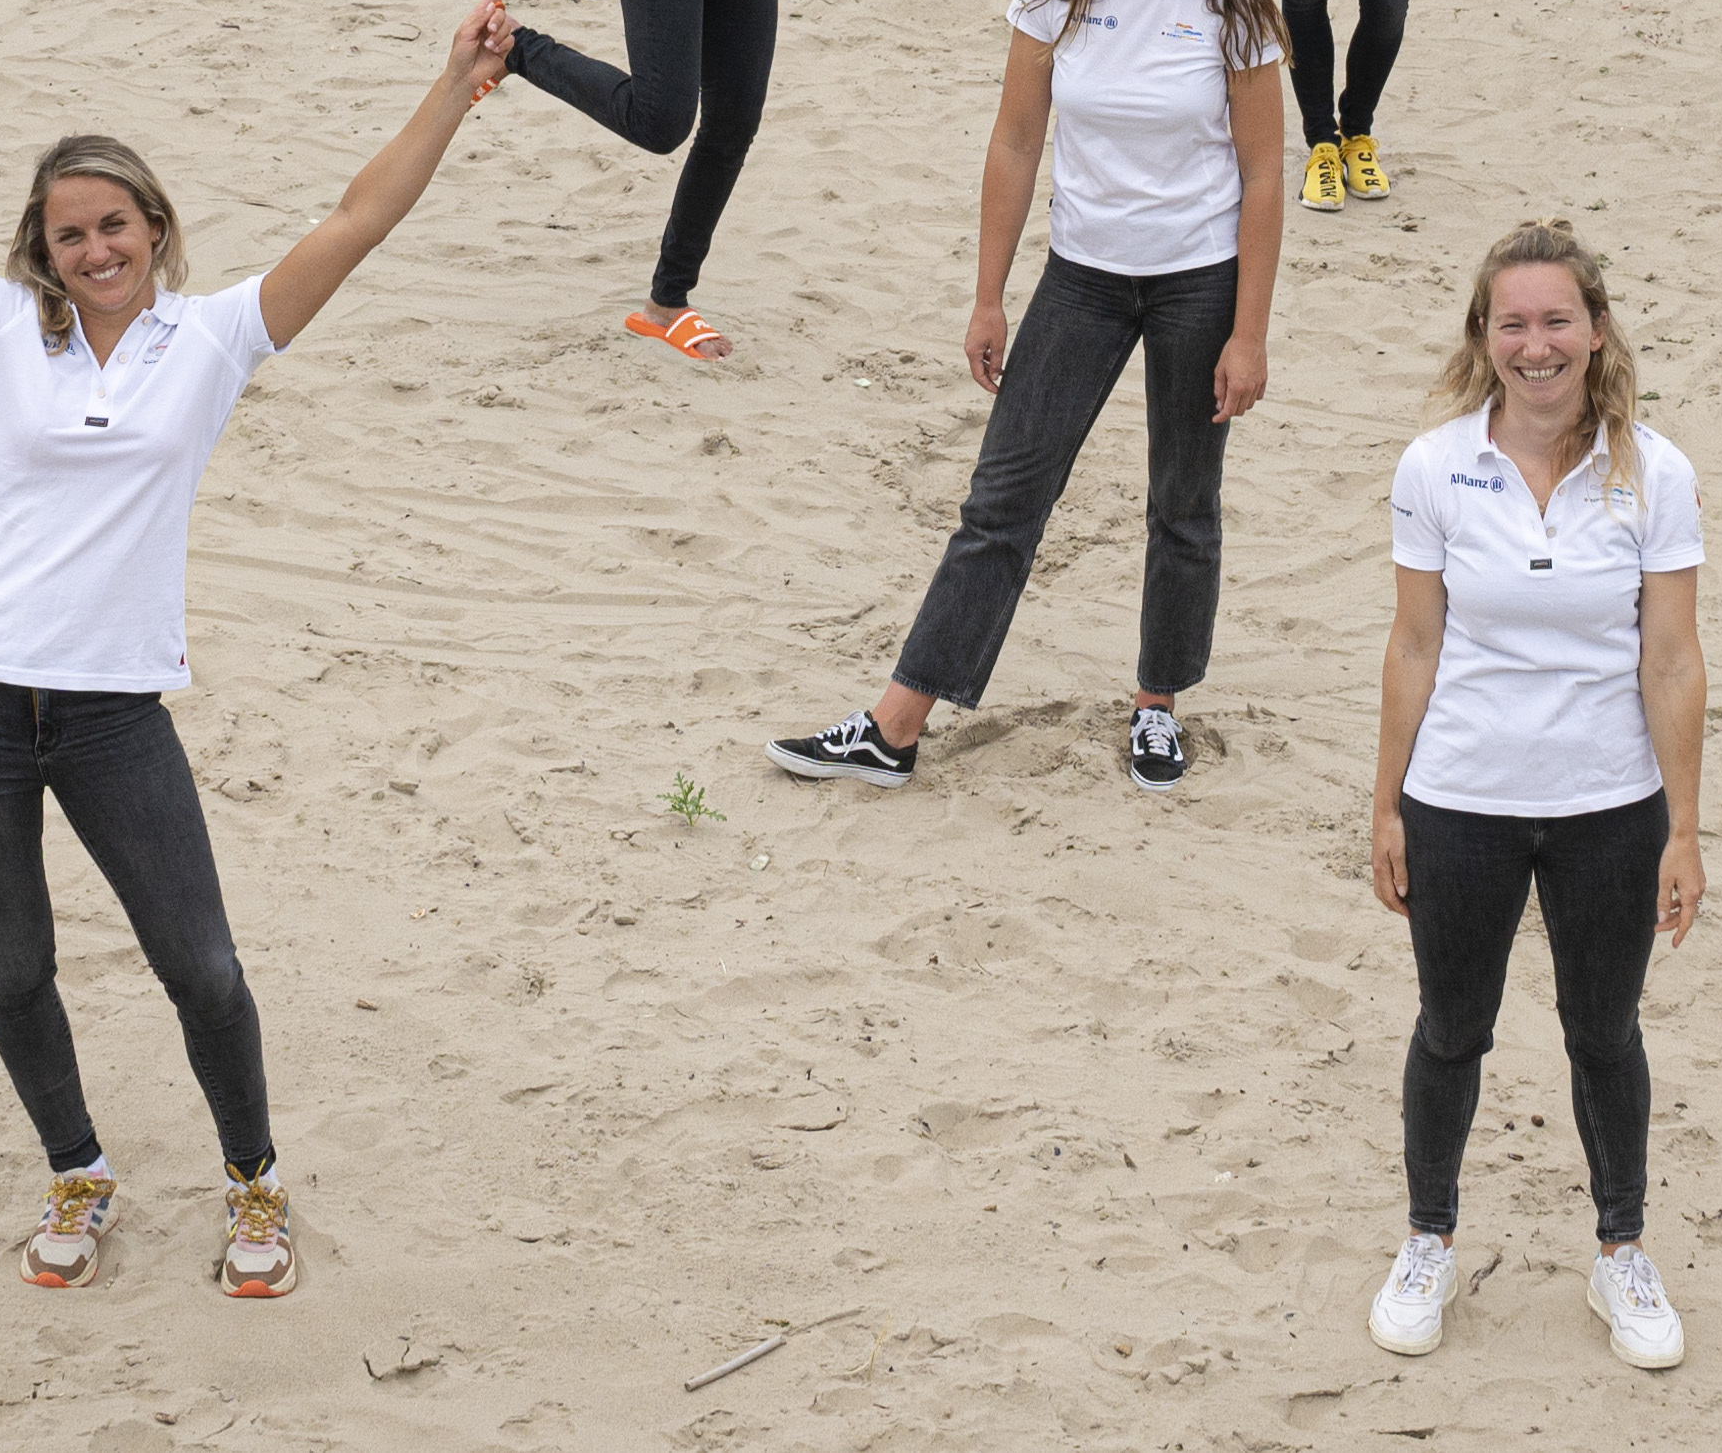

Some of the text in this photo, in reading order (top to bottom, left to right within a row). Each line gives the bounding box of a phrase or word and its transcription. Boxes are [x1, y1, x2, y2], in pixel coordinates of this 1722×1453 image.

[1319, 160, 1336, 197] HUMA
[1358, 152, 1381, 186] RAC
[1451, 473, 1488, 489] Allianz
